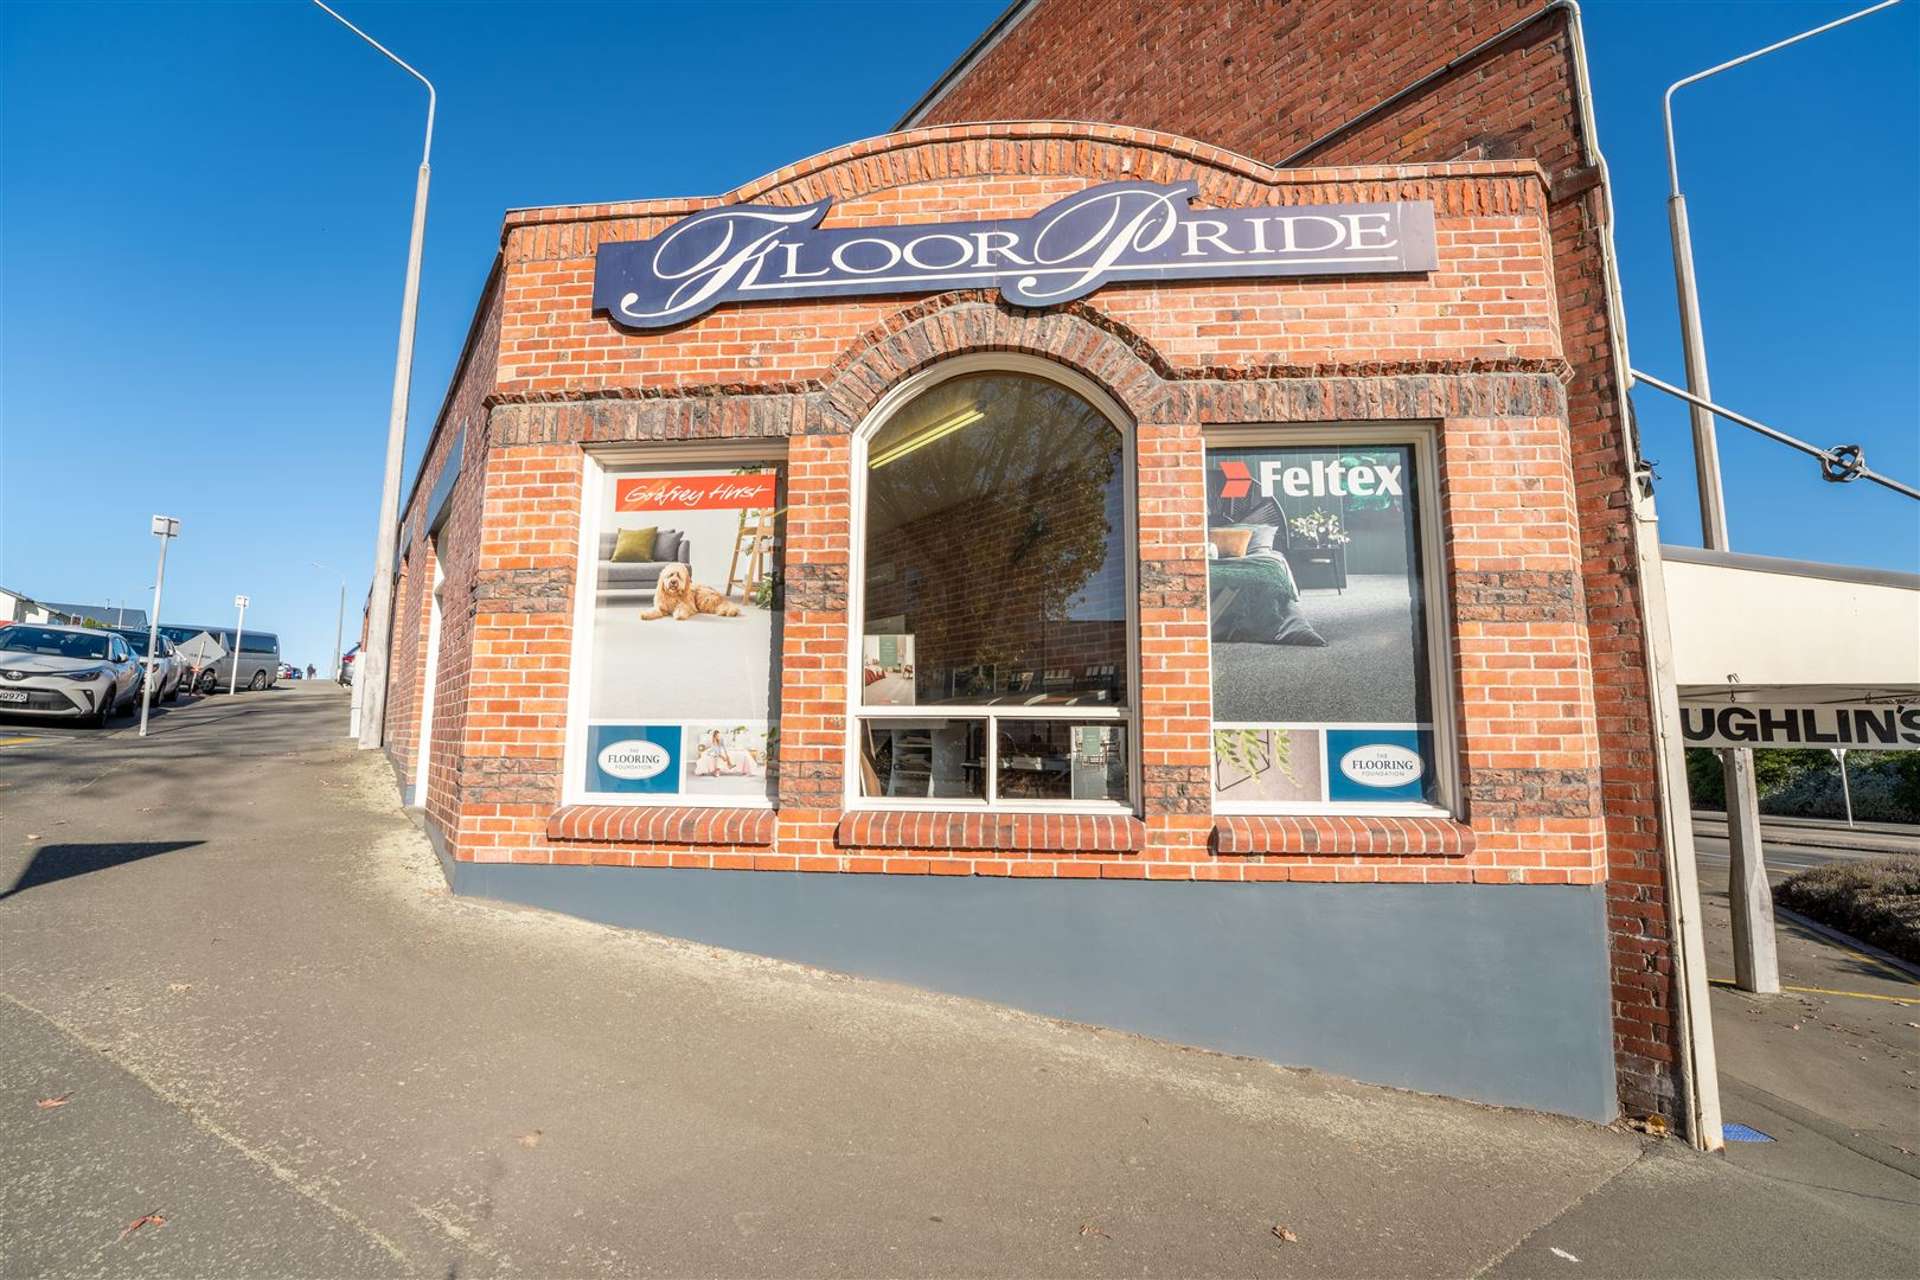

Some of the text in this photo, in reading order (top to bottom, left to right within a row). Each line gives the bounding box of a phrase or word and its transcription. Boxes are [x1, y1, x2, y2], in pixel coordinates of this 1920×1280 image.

[1259, 460, 1403, 498] Feltex
[624, 482, 772, 507] Godfrey Hirst
[608, 754, 660, 763] FLOORING
[1352, 760, 1413, 770] FLOORING
